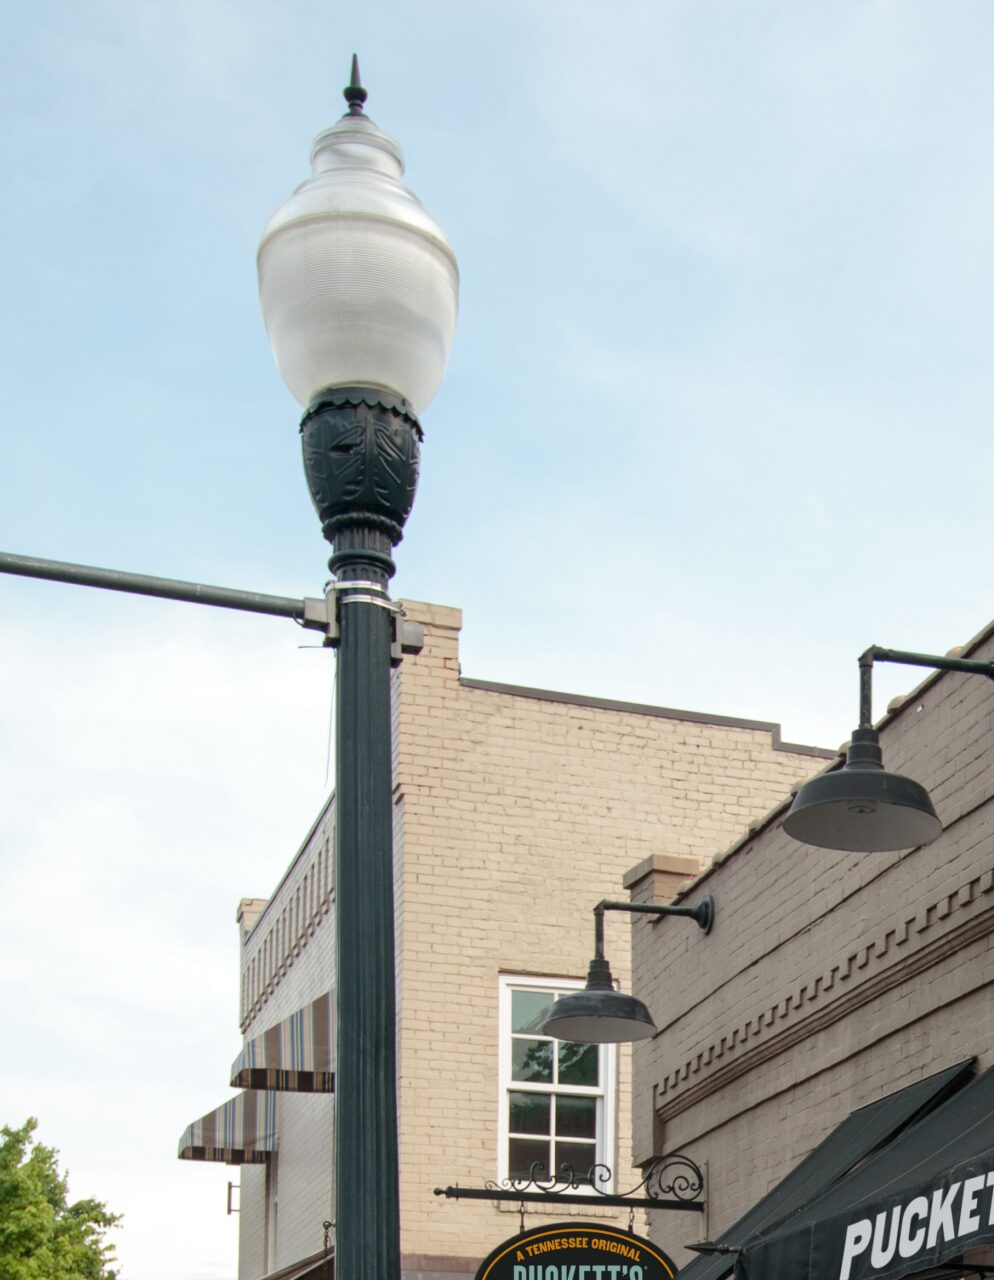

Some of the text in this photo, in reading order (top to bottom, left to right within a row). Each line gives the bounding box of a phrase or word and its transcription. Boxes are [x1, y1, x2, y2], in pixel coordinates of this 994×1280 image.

[516, 1237, 641, 1262] A TENNESSEE ORIGINAL
